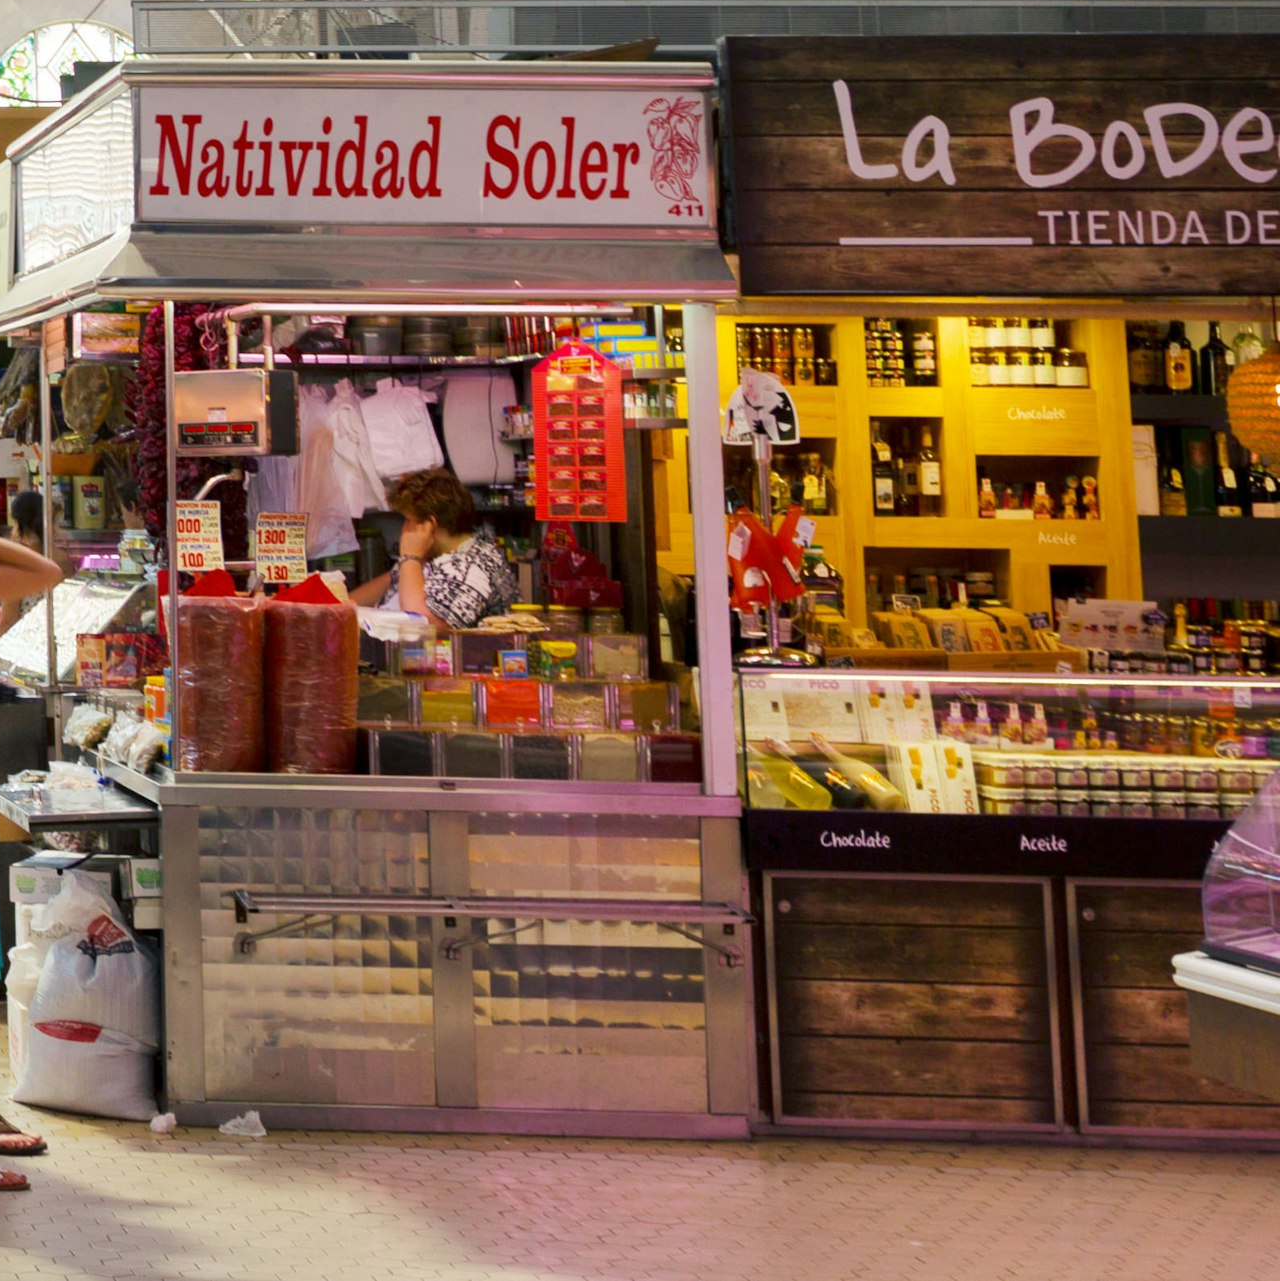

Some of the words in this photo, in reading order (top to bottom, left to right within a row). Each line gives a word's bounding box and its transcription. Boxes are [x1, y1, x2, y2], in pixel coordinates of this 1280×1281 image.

[832, 78, 957, 186] La
[1008, 96, 1280, 189] BoDe
[149, 114, 442, 198] Natividad
[483, 113, 640, 200] Soler
[668, 204, 704, 217] 411
[1037, 210, 1210, 245] TIENDA
[1225, 210, 1280, 245] DE
[1007, 405, 1067, 420] Chocolate
[177, 518, 201, 534] 000
[256, 529, 286, 545] 1300
[1038, 532, 1078, 545] Aceite
[180, 552, 204, 568] 100
[266, 564, 289, 581] 130
[744, 680, 767, 689] ICO
[809, 679, 840, 690] PICO
[820, 829, 891, 849] Chocolate
[1019, 834, 1068, 852] Aceite
